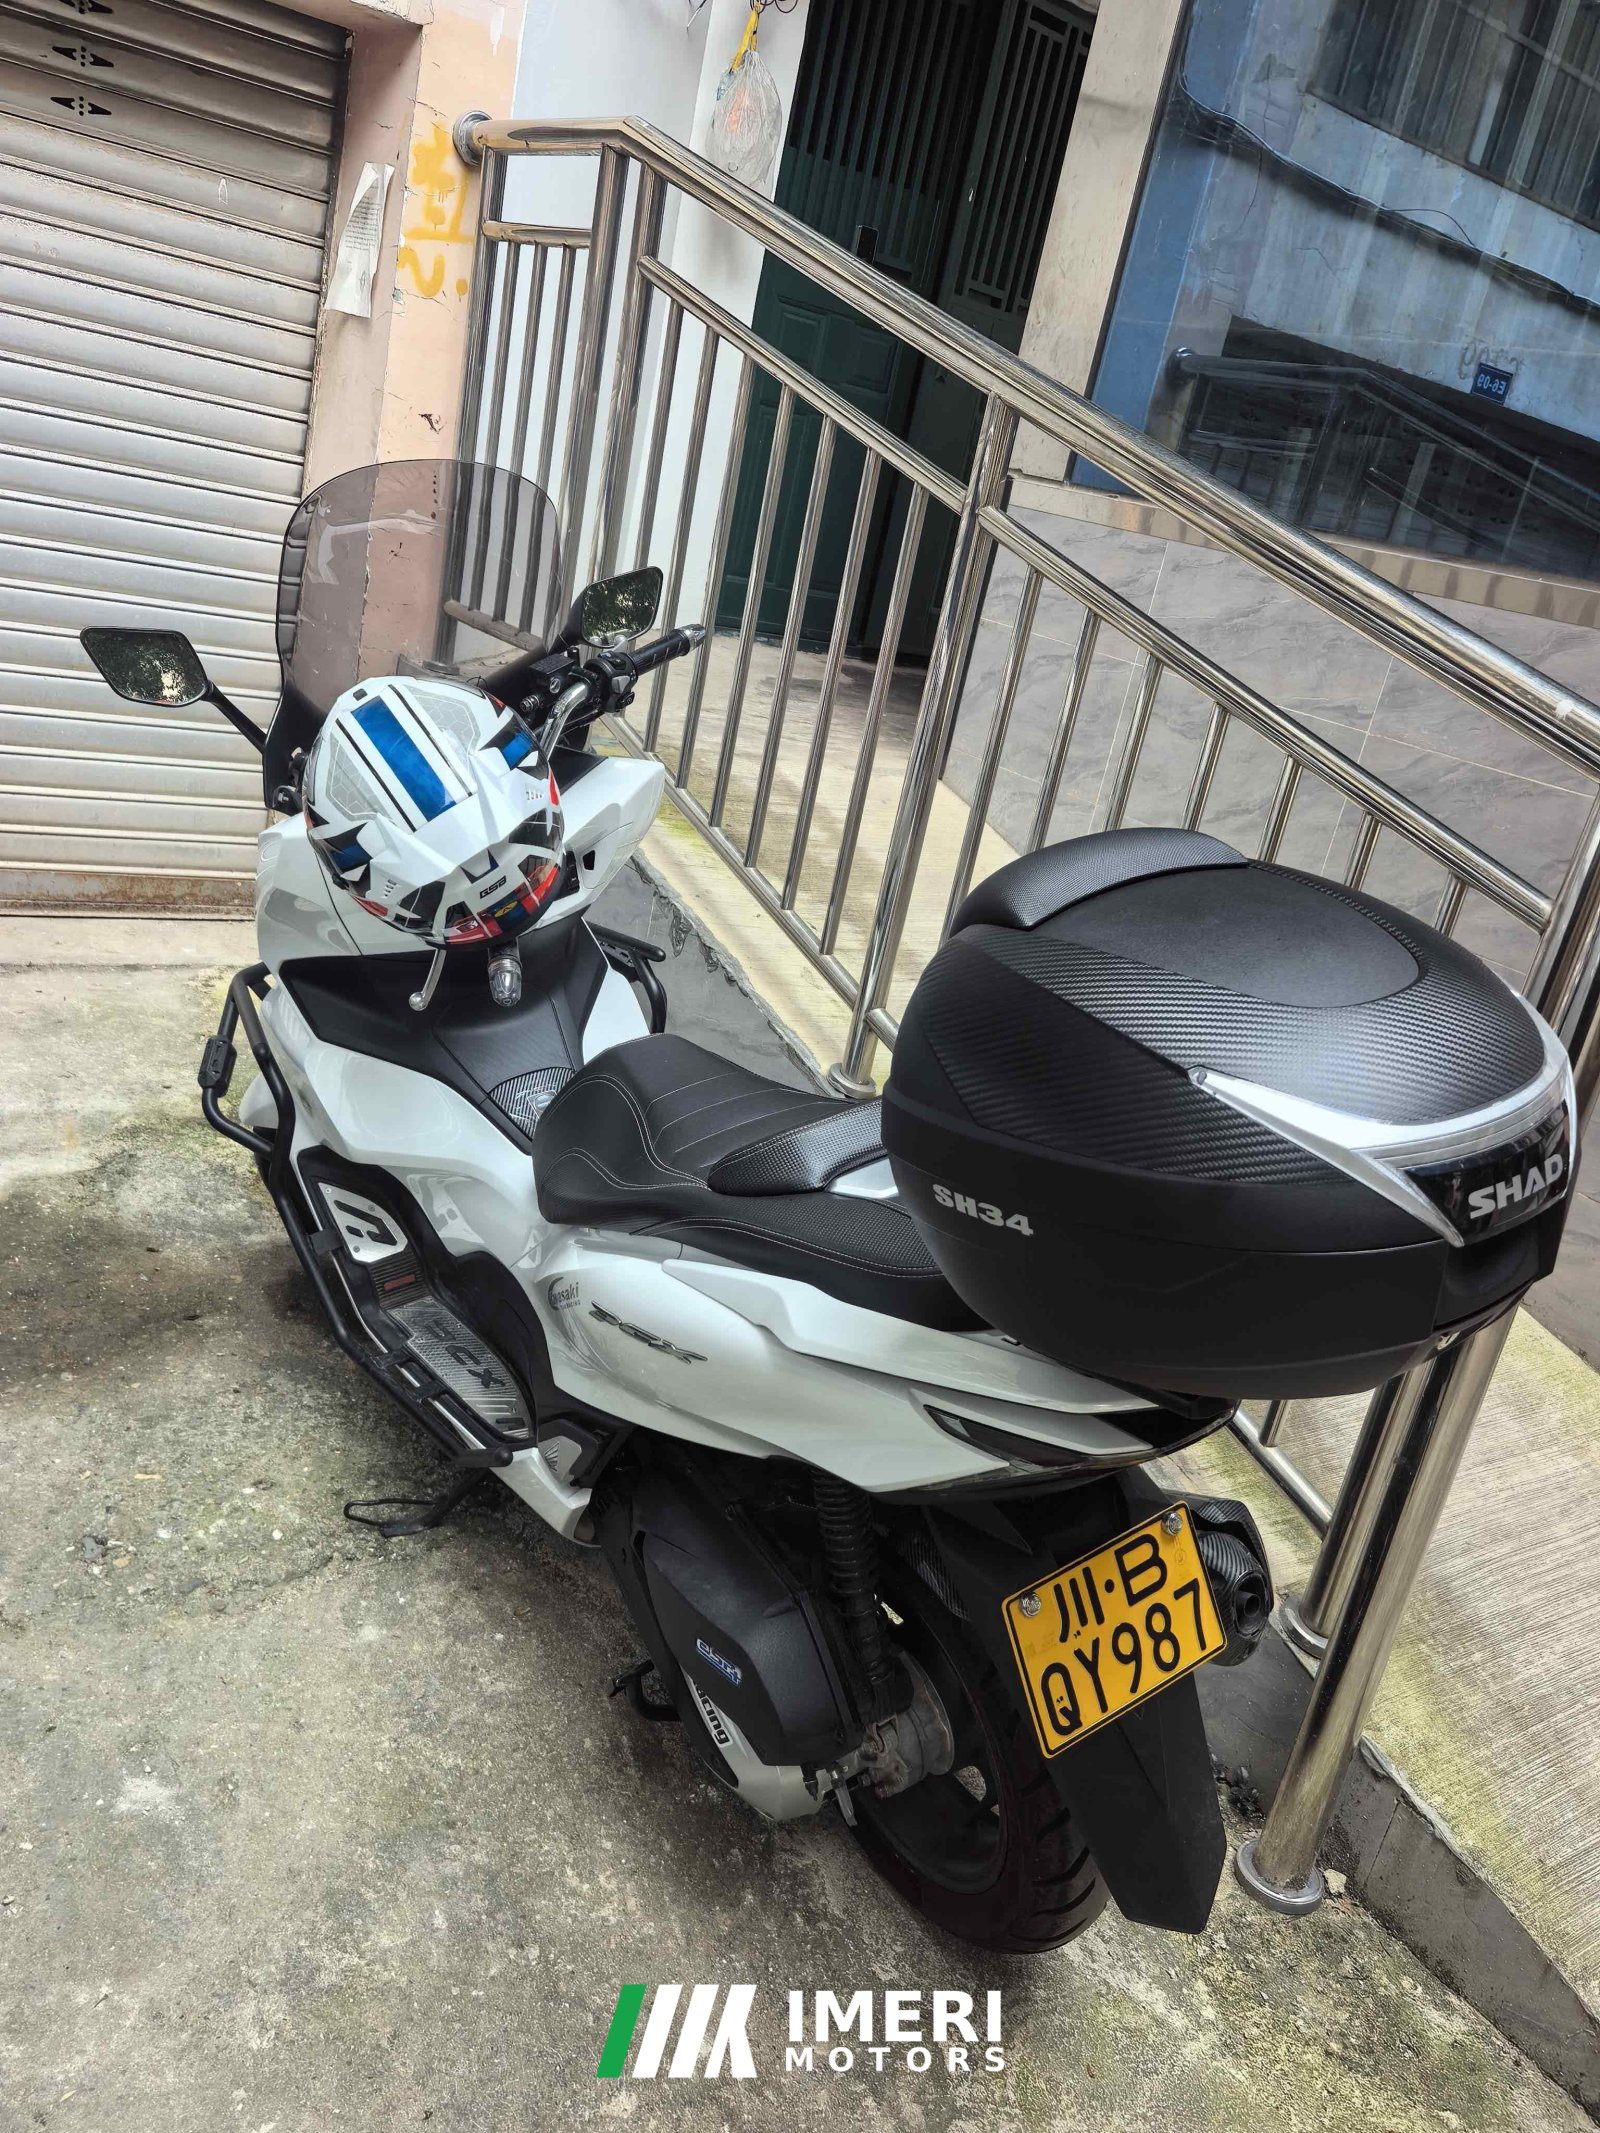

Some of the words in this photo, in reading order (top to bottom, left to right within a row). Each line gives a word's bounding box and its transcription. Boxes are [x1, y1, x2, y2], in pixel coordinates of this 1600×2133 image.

[932, 1183, 1034, 1237] SH34
[1468, 1153, 1564, 1220] SHAD
[1040, 1577, 1208, 1736] QY987
